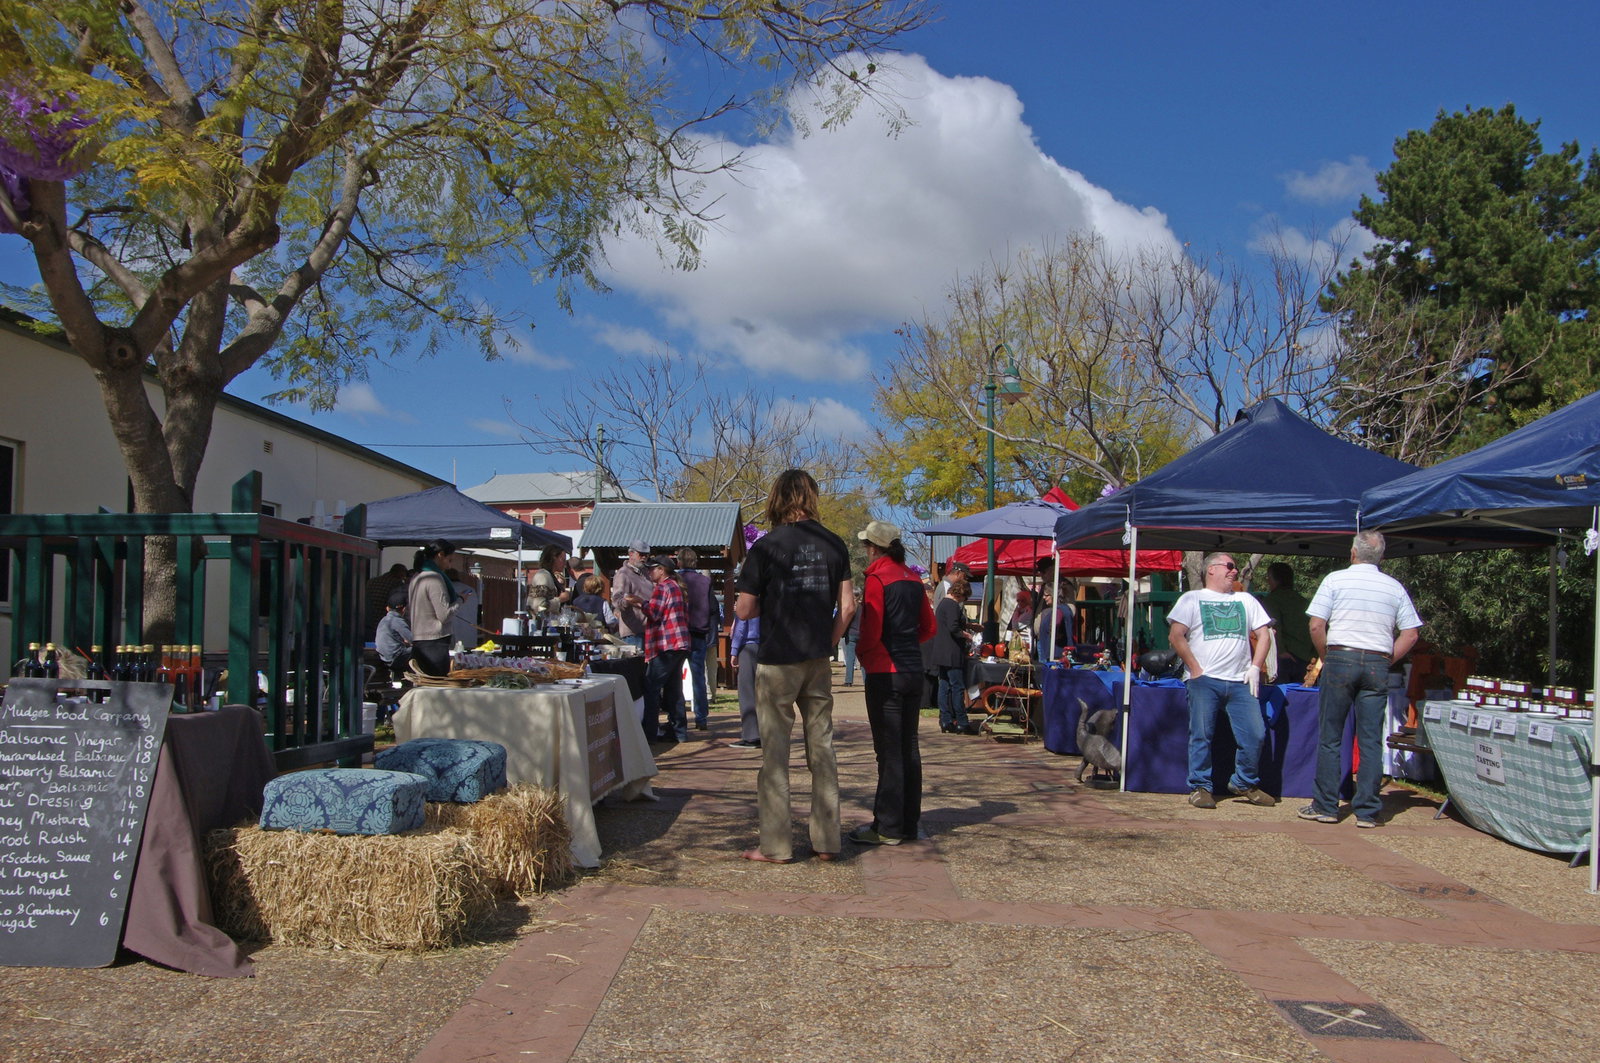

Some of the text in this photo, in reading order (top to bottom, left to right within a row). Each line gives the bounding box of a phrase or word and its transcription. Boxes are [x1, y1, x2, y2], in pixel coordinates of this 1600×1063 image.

[2, 704, 50, 721] Mudgee
[0, 730, 155, 751] Balsamic Vinegar 18
[74, 750, 127, 762] Balsamic
[135, 751, 151, 764] 18
[1479, 744, 1493, 755] FREE
[1476, 755, 1501, 769] TASTING
[58, 764, 117, 778] Balsamic
[133, 768, 149, 782] 18
[48, 782, 109, 794] Balsamic
[128, 784, 145, 798] 18
[27, 793, 93, 810] Dressing
[121, 800, 138, 814] 14
[30, 811, 90, 828] Mustard
[120, 817, 138, 829] 14
[38, 830, 87, 846] Relish
[117, 833, 133, 847] 14
[56, 851, 91, 863] Sauce
[112, 850, 128, 863] 14
[113, 870, 122, 881] 6
[109, 888, 118, 899] 6
[0, 911, 109, 934] ugat 6
